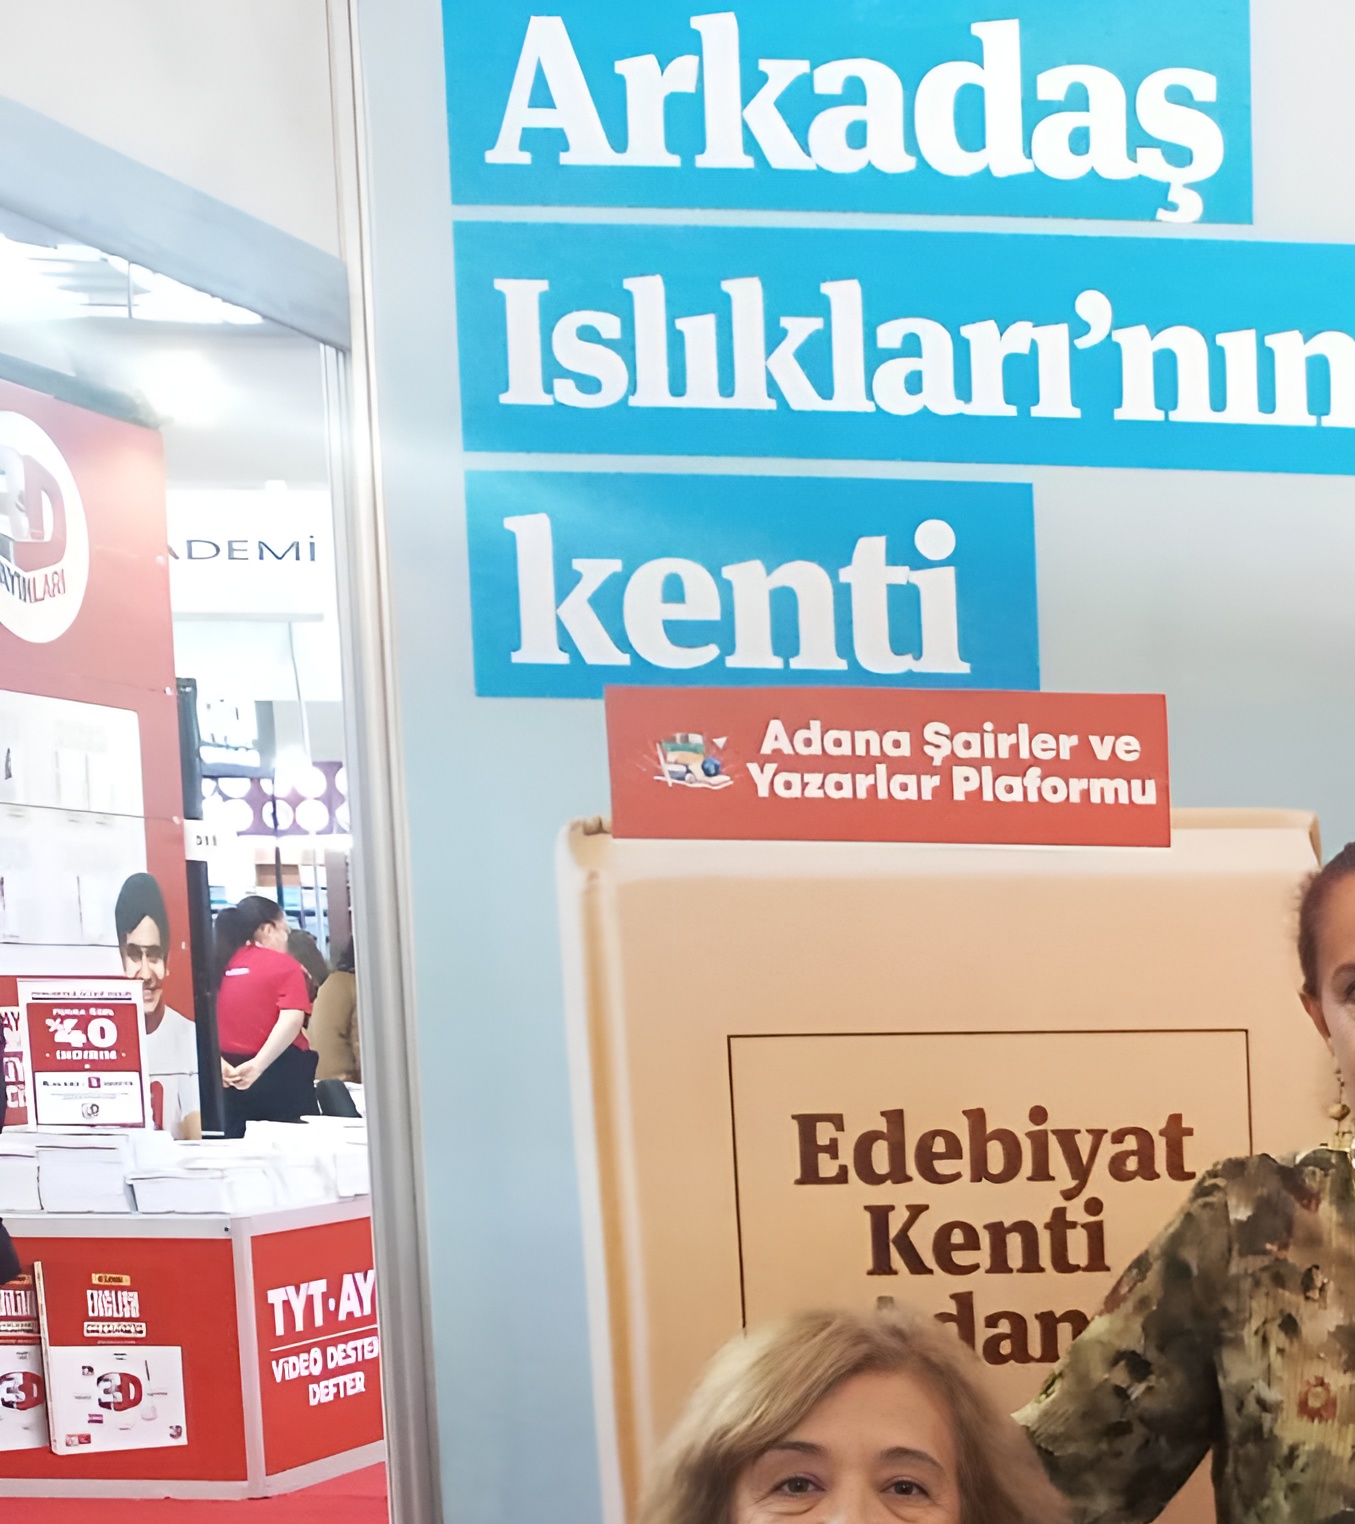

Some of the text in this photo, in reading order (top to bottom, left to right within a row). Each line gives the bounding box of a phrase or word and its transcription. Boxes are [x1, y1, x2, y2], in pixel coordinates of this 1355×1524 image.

[484, 11, 1224, 223] Arkadaş
[502, 512, 971, 675] kenti
[746, 763, 1158, 805] Yazarlar Plaformu
[760, 718, 1141, 766] Adana Şairler ve
[791, 1105, 1197, 1202] Edebiyat
[863, 1197, 1111, 1276] Kenti
